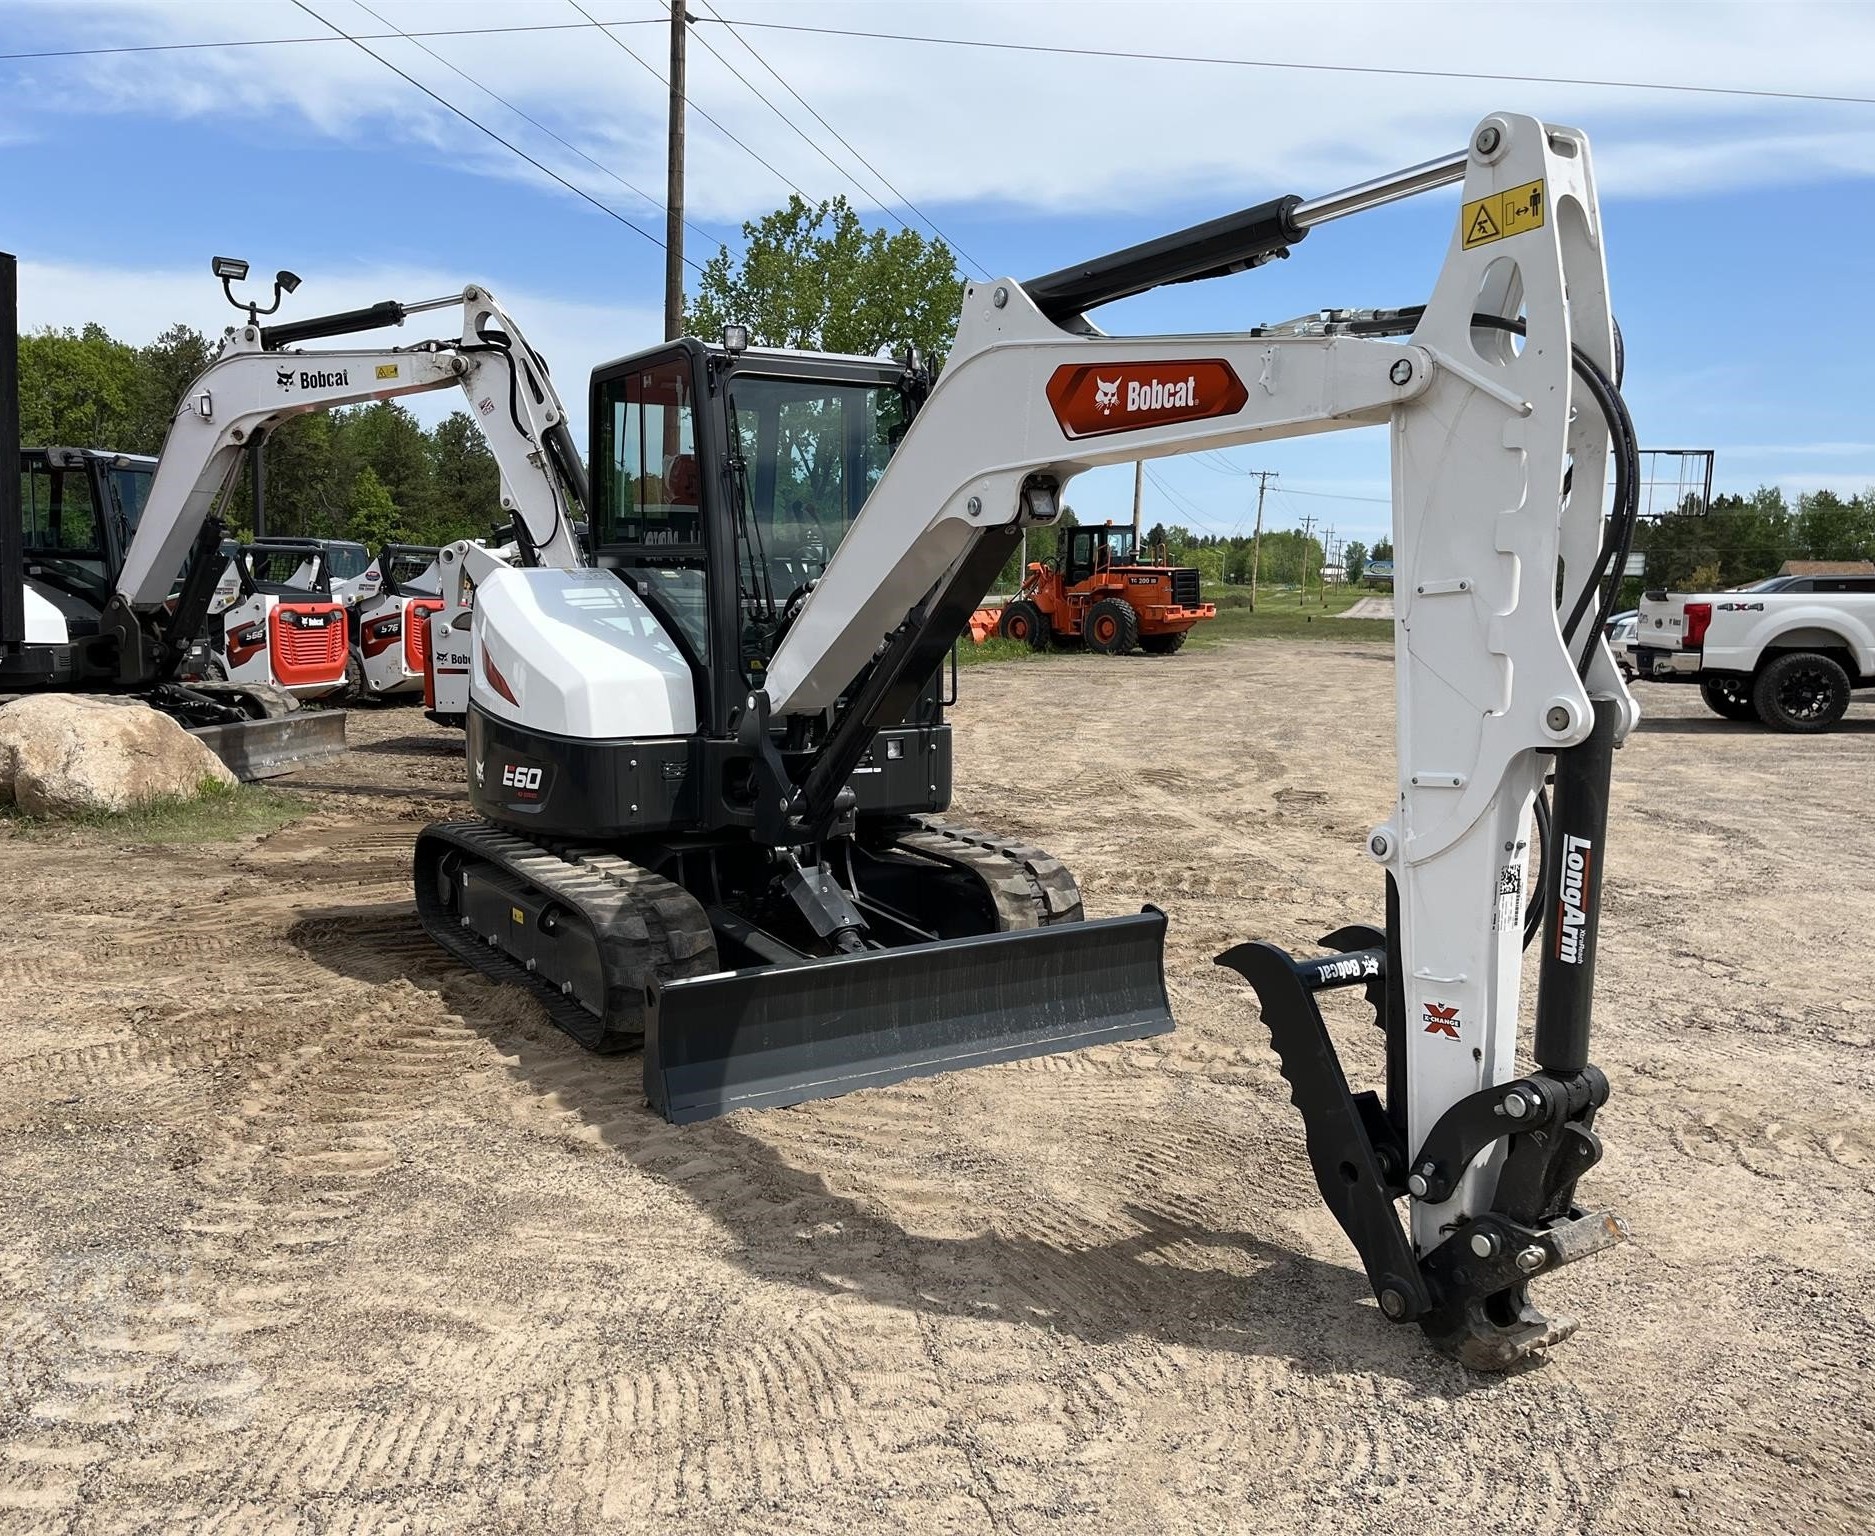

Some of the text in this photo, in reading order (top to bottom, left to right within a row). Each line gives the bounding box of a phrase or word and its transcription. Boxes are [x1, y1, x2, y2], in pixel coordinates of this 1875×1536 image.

[300, 369, 349, 389] Bobcat
[1127, 376, 1196, 411] Bobcat
[502, 764, 542, 790] E60
[1561, 834, 1591, 964] LongArm
[1318, 959, 1360, 982] Bobcat
